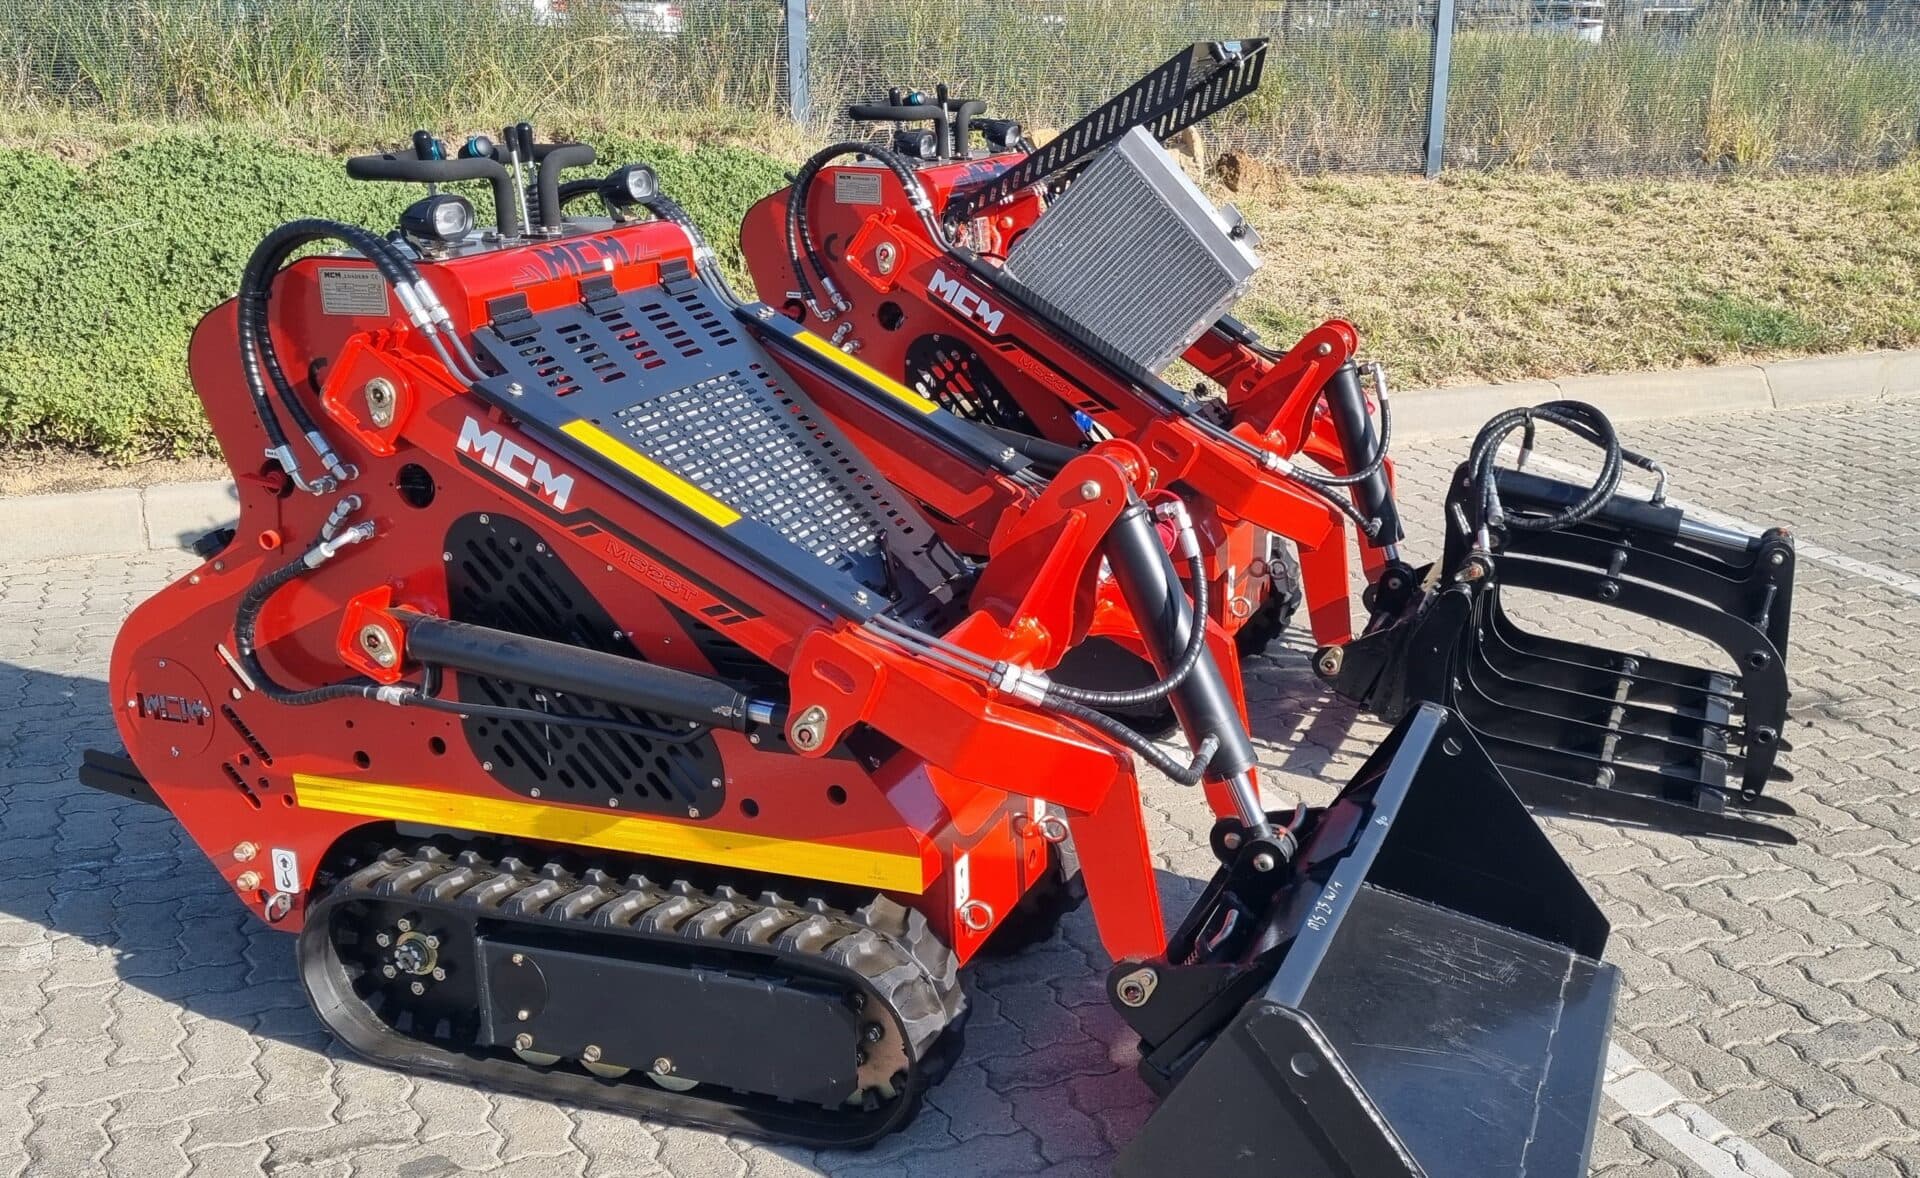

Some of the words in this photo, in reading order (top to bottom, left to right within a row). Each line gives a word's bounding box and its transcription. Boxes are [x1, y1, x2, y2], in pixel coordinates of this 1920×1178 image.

[324, 271, 341, 279] MCM
[534, 236, 631, 281] MCM
[927, 269, 1005, 334] MCM
[456, 415, 575, 511] MCM
[604, 539, 699, 601] MS23T
